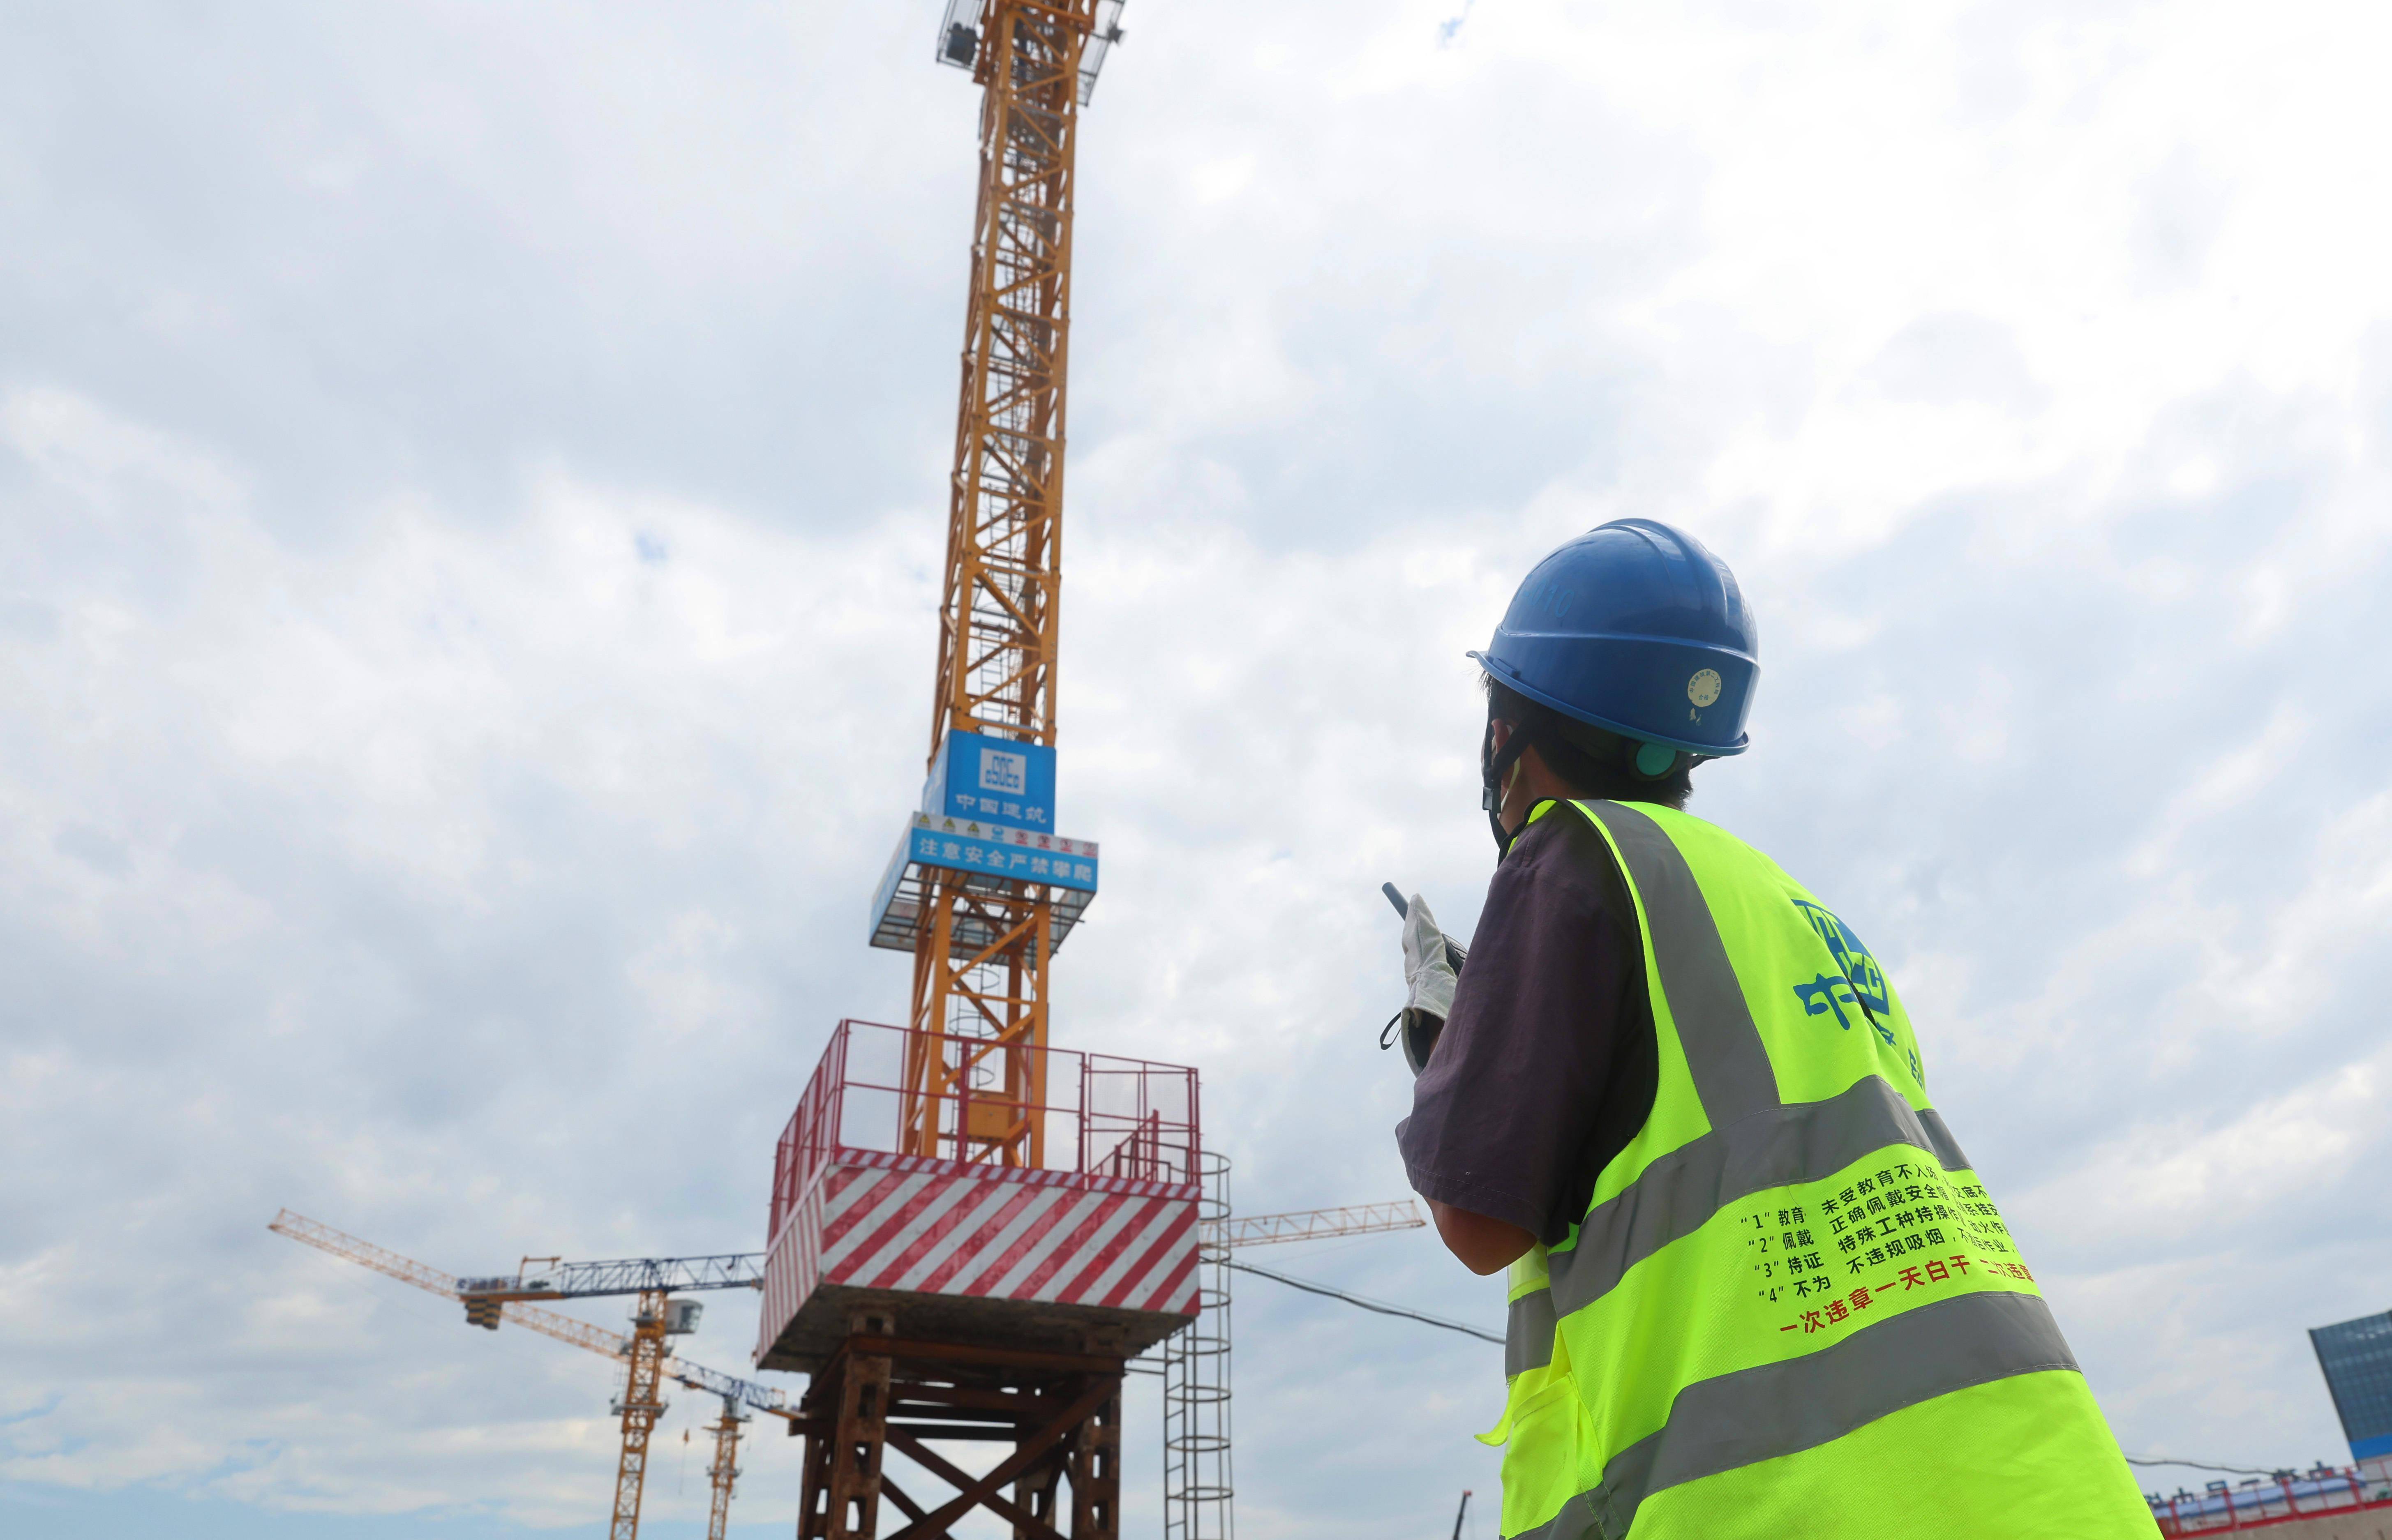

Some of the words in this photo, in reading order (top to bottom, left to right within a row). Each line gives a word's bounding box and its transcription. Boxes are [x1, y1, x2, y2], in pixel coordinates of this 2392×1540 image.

[956, 794, 1046, 823] 中国建筑
[919, 837, 1092, 882] 注意安全严禁攀爬
[1780, 1255, 1970, 1333] 一次违章一天白干
